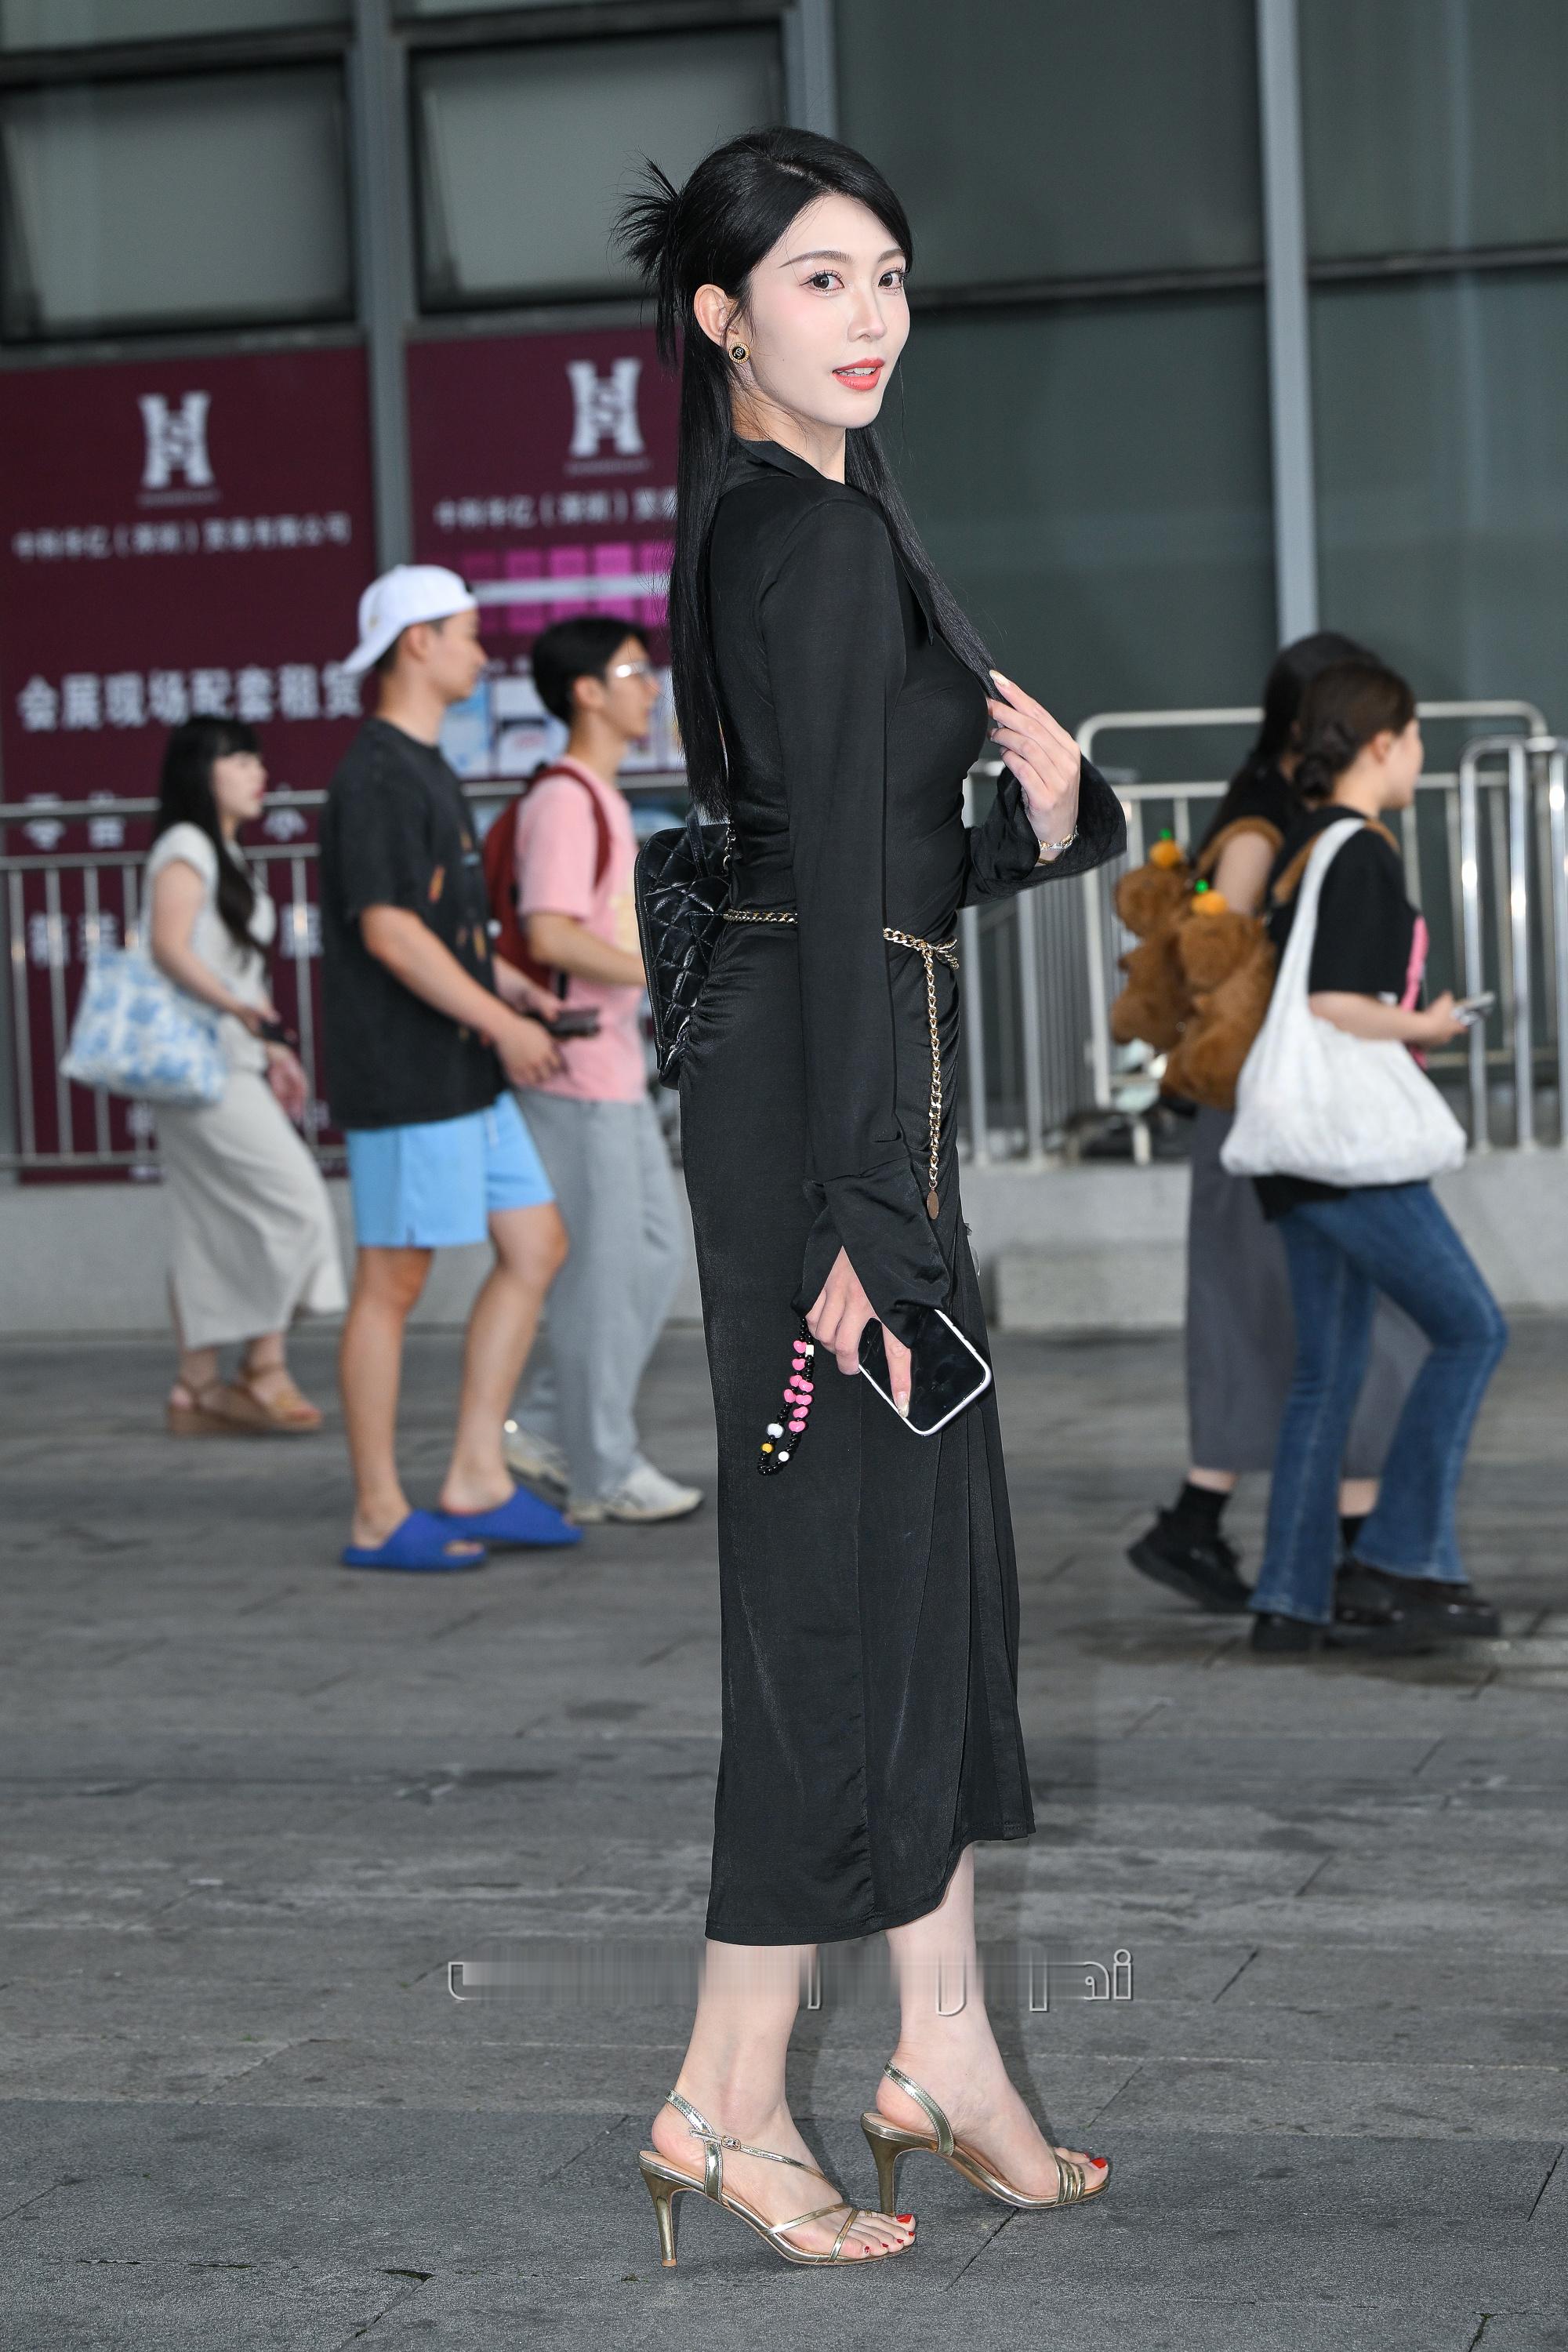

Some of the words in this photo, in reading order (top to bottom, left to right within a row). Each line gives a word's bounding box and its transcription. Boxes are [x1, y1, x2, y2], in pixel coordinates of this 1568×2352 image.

[18, 662, 363, 731] 会展现场配套租赁
